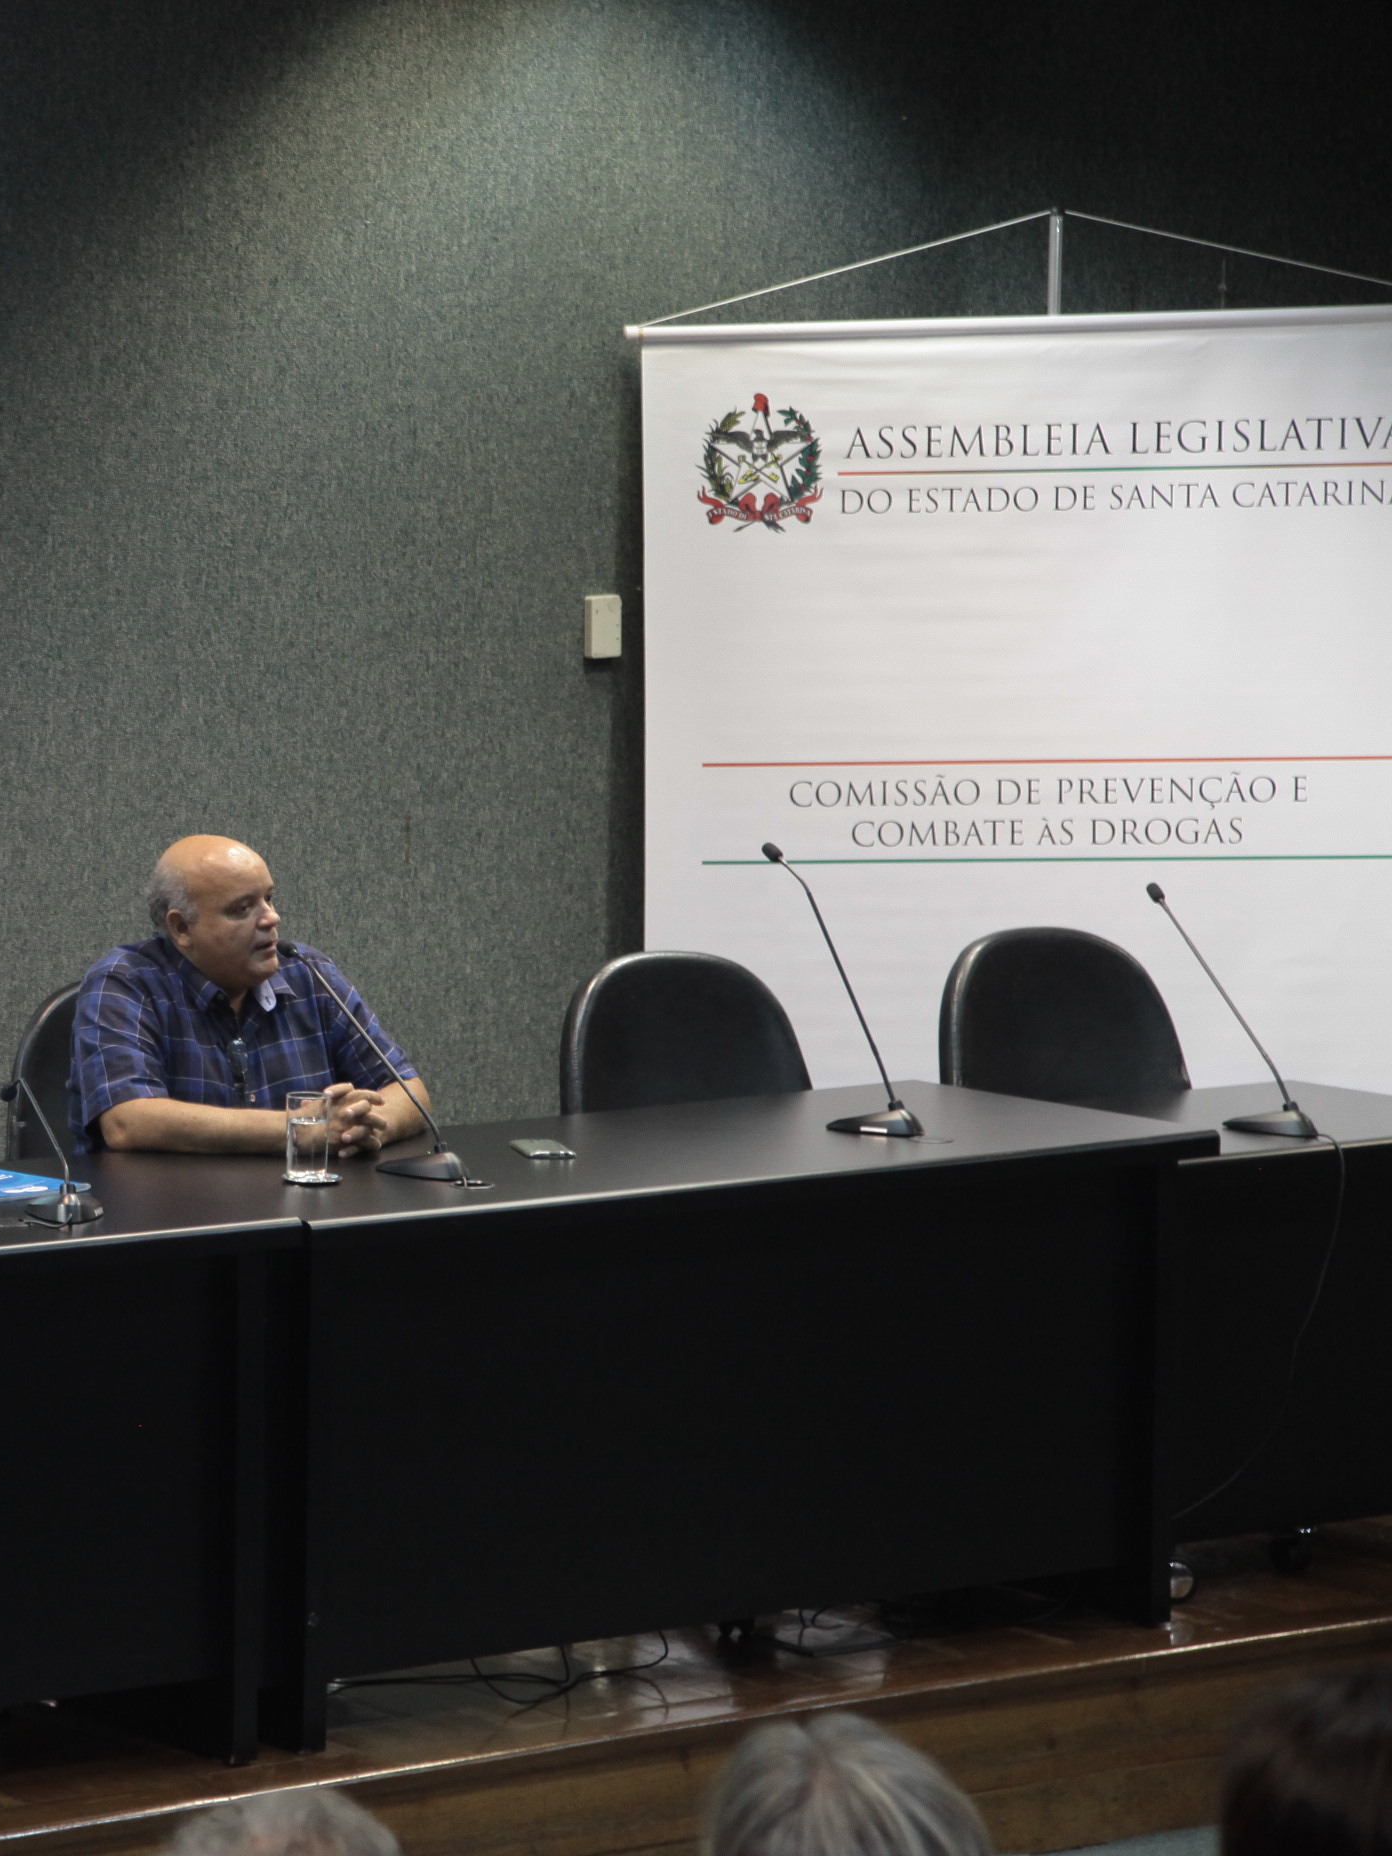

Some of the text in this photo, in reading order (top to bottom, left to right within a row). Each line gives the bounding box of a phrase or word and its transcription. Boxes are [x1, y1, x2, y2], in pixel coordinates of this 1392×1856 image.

[845, 421, 1114, 460] ASSEMBLEIA
[839, 479, 1392, 515] DO ESTADO DE SANTA CATARIN
[789, 771, 1309, 811] COMISSÃO DE PREVENÇÃO E
[851, 816, 1245, 848] COMBATE ÀS DROGAS
